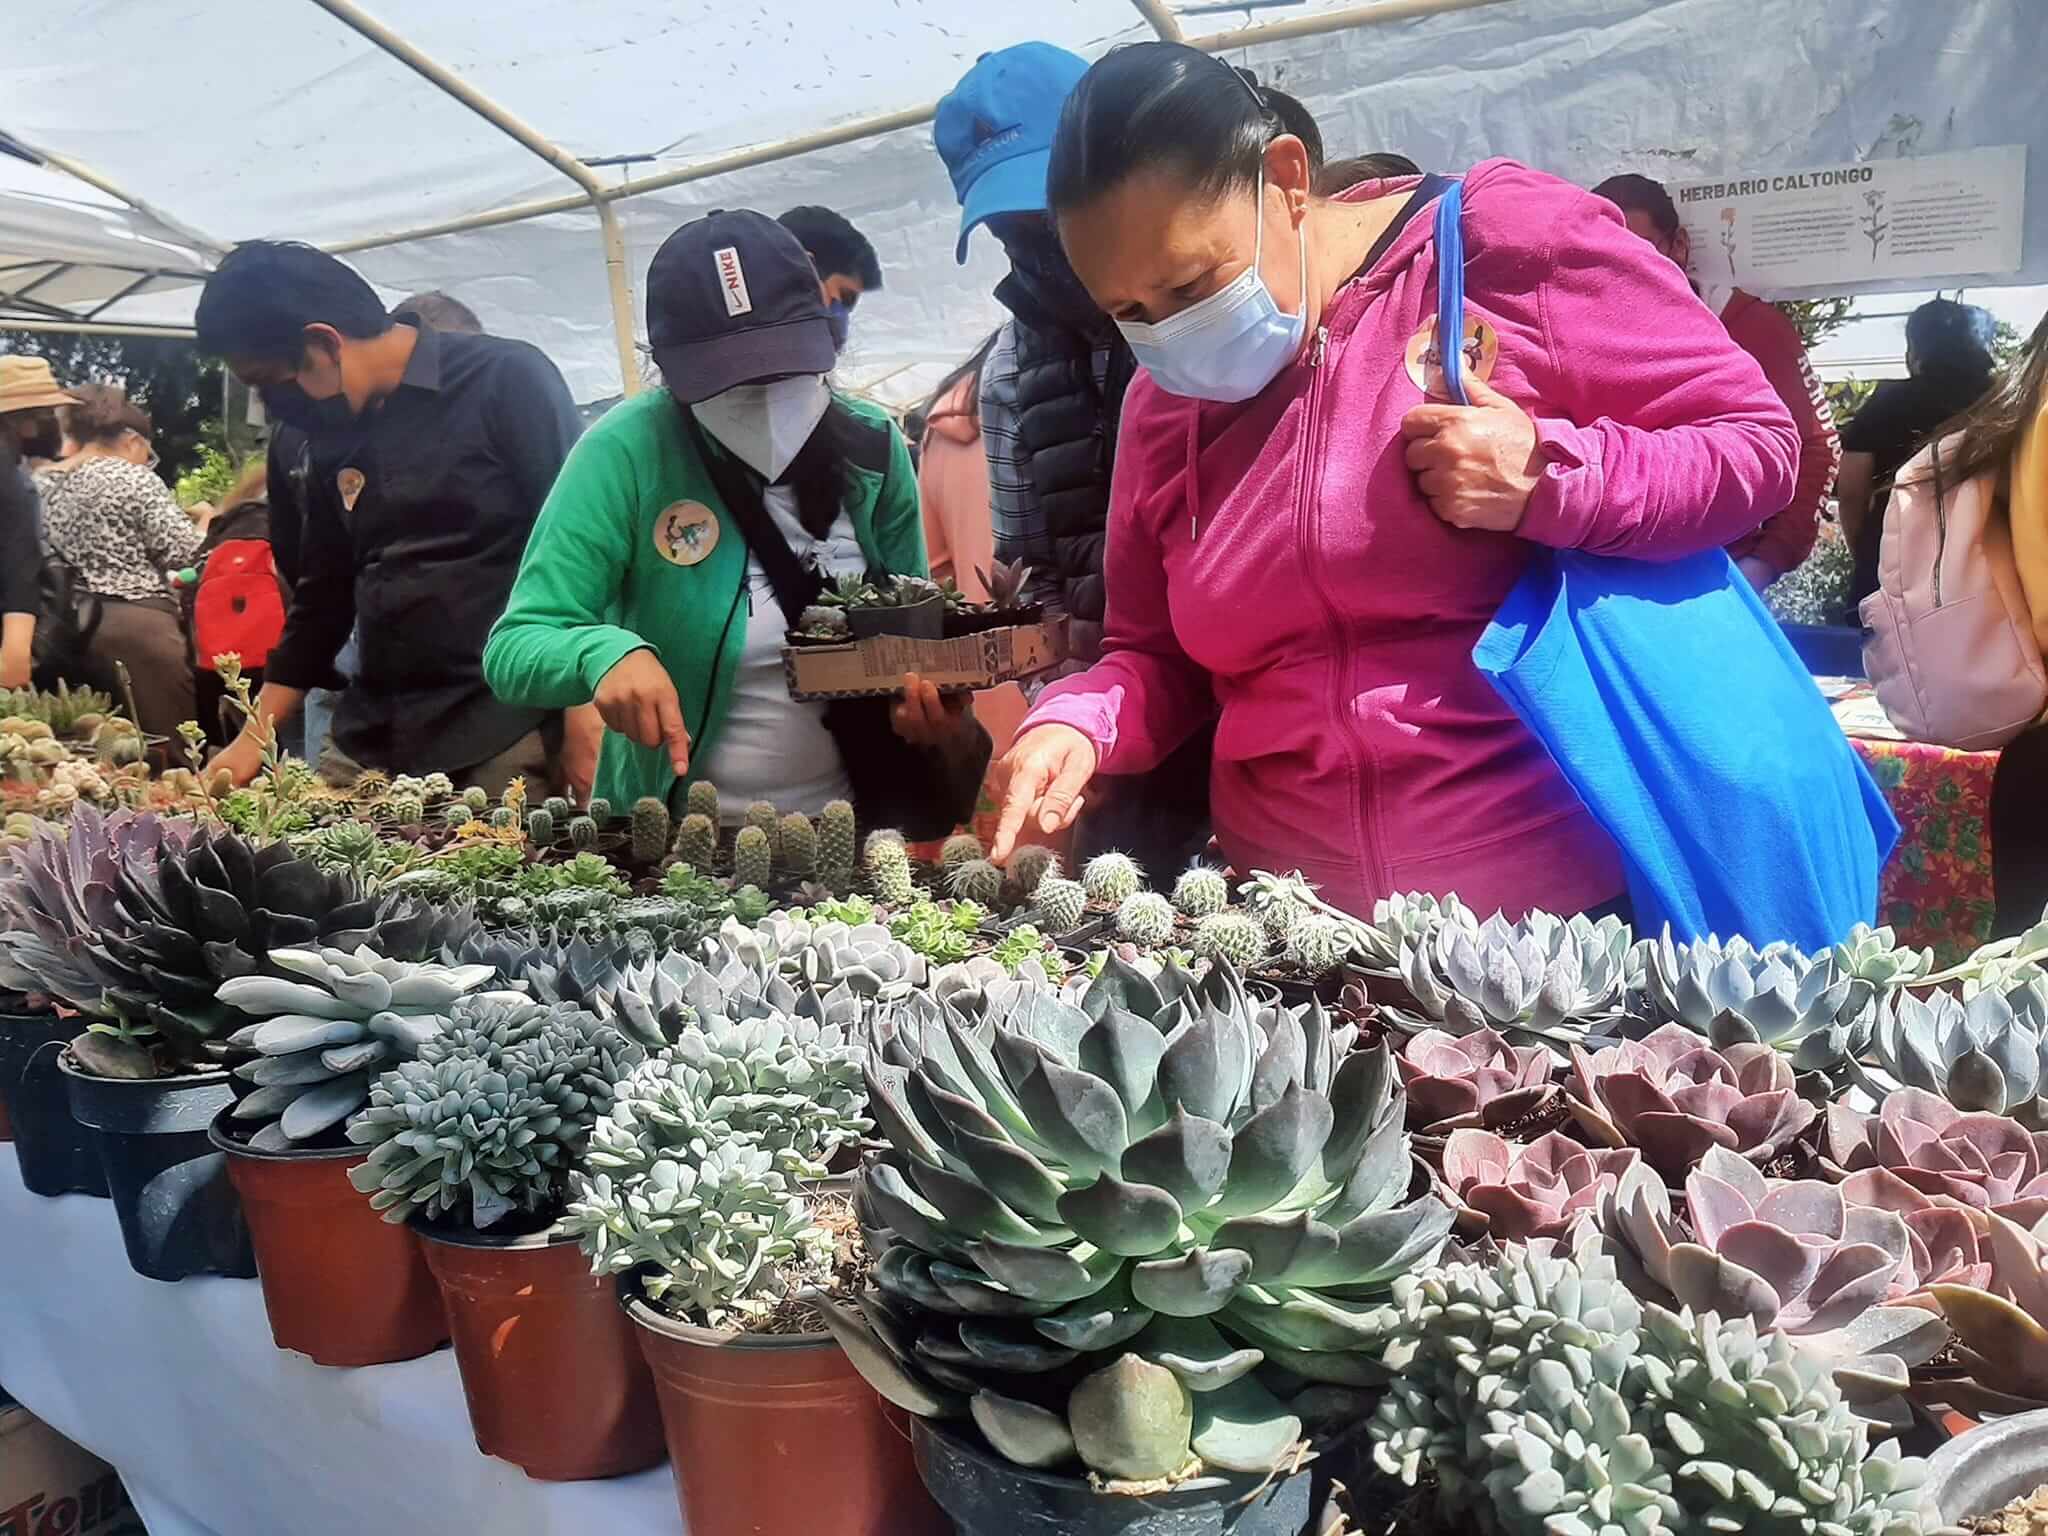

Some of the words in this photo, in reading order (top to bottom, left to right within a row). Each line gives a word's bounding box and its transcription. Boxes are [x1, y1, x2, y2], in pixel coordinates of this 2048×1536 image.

[1680, 179, 1768, 203] HERBARIO
[1772, 167, 1873, 192] CALTONGO
[719, 251, 740, 290] NIKE
